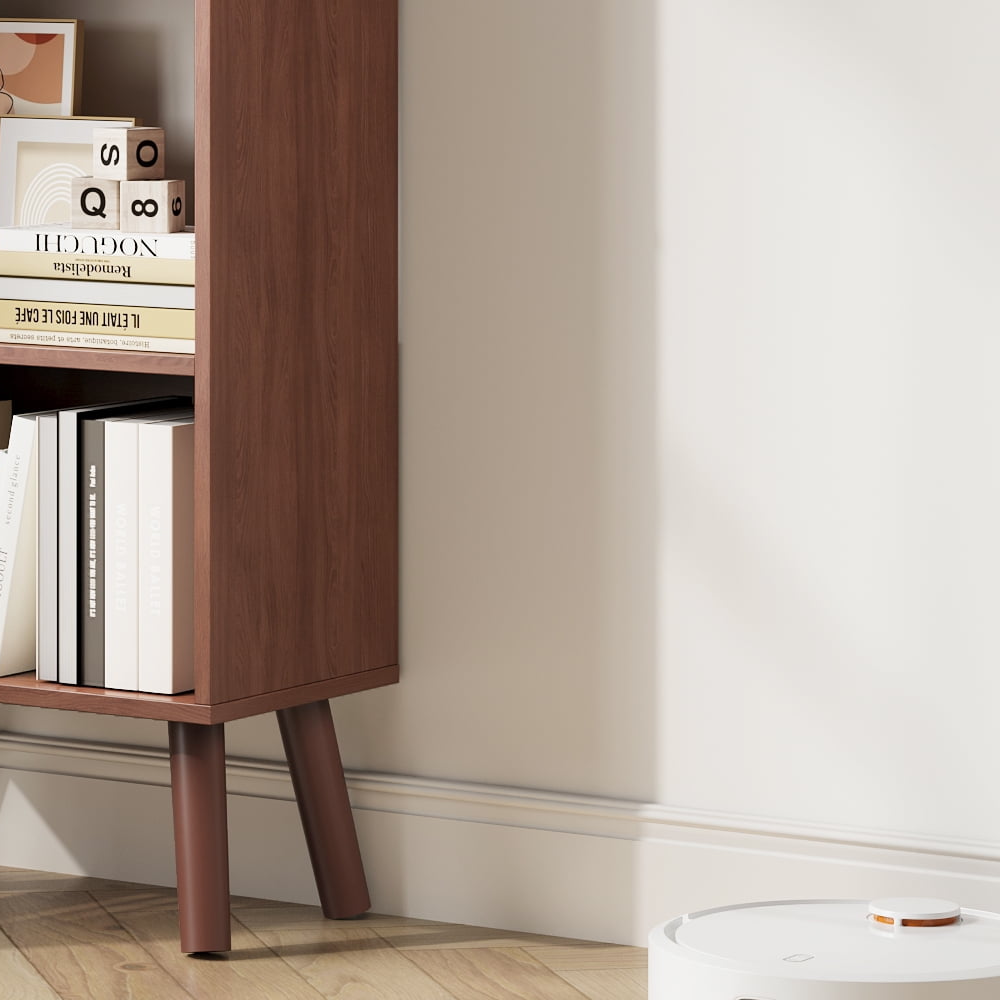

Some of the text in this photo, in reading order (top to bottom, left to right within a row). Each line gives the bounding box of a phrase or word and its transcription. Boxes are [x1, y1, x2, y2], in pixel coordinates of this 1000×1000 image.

[100, 143, 120, 166] S
[136, 140, 158, 168] O
[80, 187, 107, 219] Q
[131, 199, 159, 218] 8
[35, 233, 158, 257] NOGUCHI
[53, 262, 132, 278] Remodelista
[15, 307, 140, 331] IL ÉTAIT UNE FOIS LE CAFÉ
